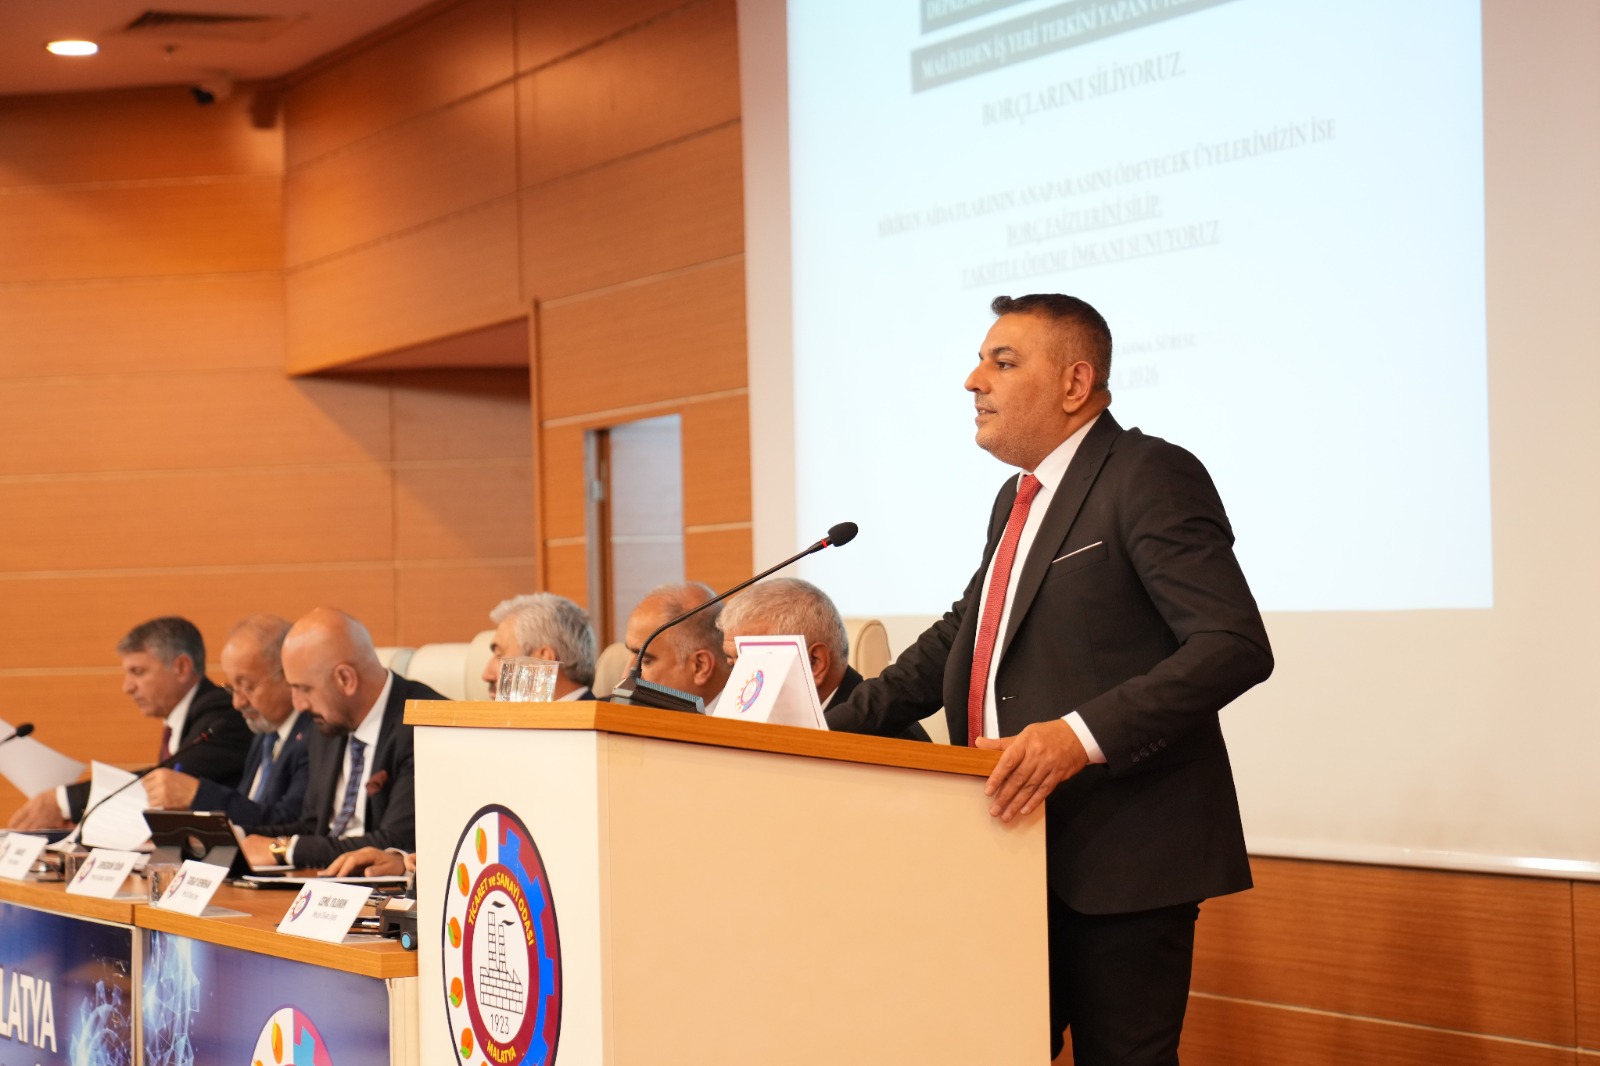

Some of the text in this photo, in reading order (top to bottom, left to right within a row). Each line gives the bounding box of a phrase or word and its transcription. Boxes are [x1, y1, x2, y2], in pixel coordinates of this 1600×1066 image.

[1008, 20, 1039, 55] YERİ
[1039, 3, 1097, 44] TERKİNİ
[982, 51, 1186, 127] BORÇLARINI SİLİYORUZ.
[1114, 149, 1191, 186] ÖDEYECEK
[1193, 120, 1307, 169] ÜYELERİMİZİN
[1310, 115, 1337, 144] İSE
[1006, 217, 1045, 246] BORÇ
[1126, 218, 1222, 256] SUNUYORUZ
[468, 871, 535, 946] TİCARET ve SANAYİ ODASI
[490, 1013, 510, 1035] 1923
[486, 1039, 517, 1064] MALATYA
